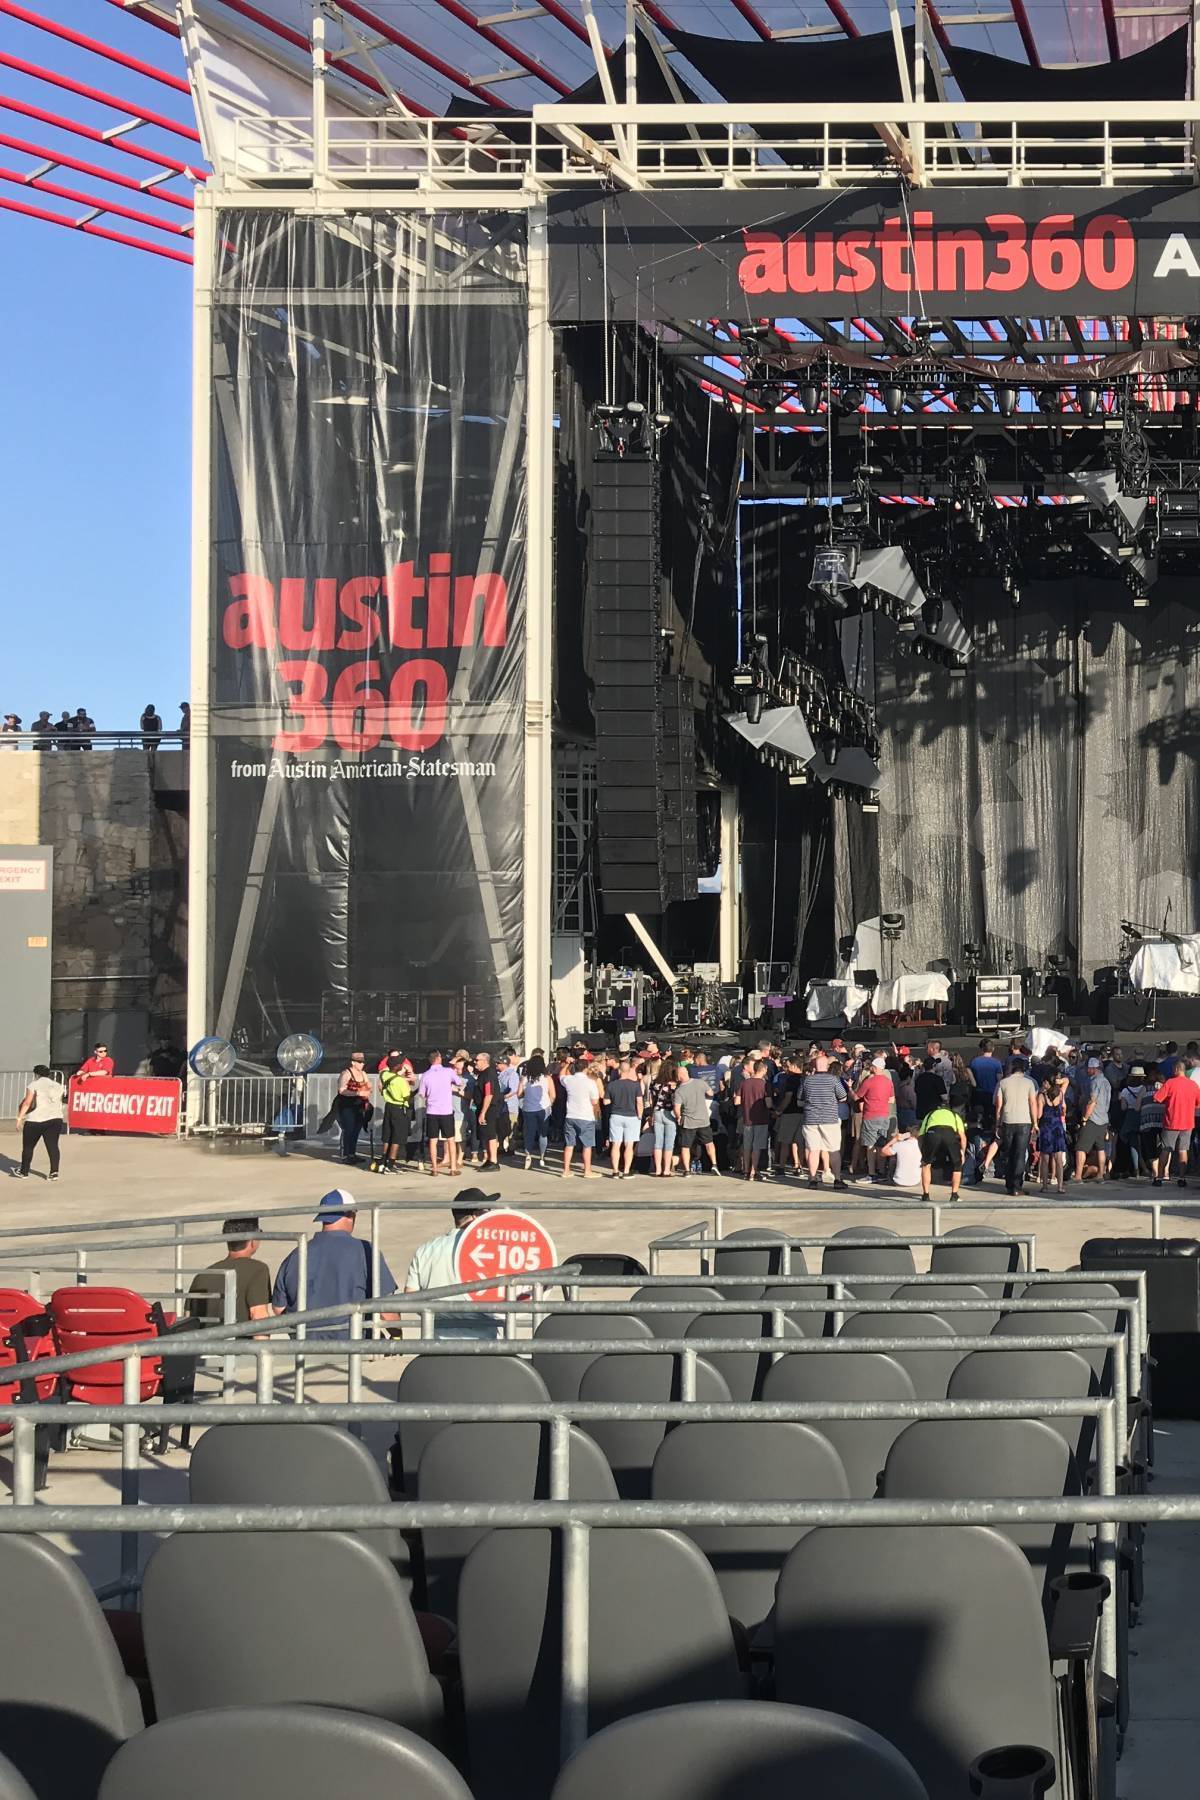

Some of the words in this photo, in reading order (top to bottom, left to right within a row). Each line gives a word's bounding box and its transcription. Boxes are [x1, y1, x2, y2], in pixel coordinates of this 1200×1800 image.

[738, 211, 1135, 294] austin360
[222, 552, 508, 651] austin
[271, 658, 448, 753] 360
[231, 760, 266, 778] from
[267, 758, 327, 780] Austin
[329, 756, 497, 780] American-Statesman
[72, 1091, 145, 1116] EMERGENCY
[145, 1095, 175, 1117] EXIT
[476, 1228, 537, 1243] SECTIONS
[497, 1244, 541, 1271] 105
